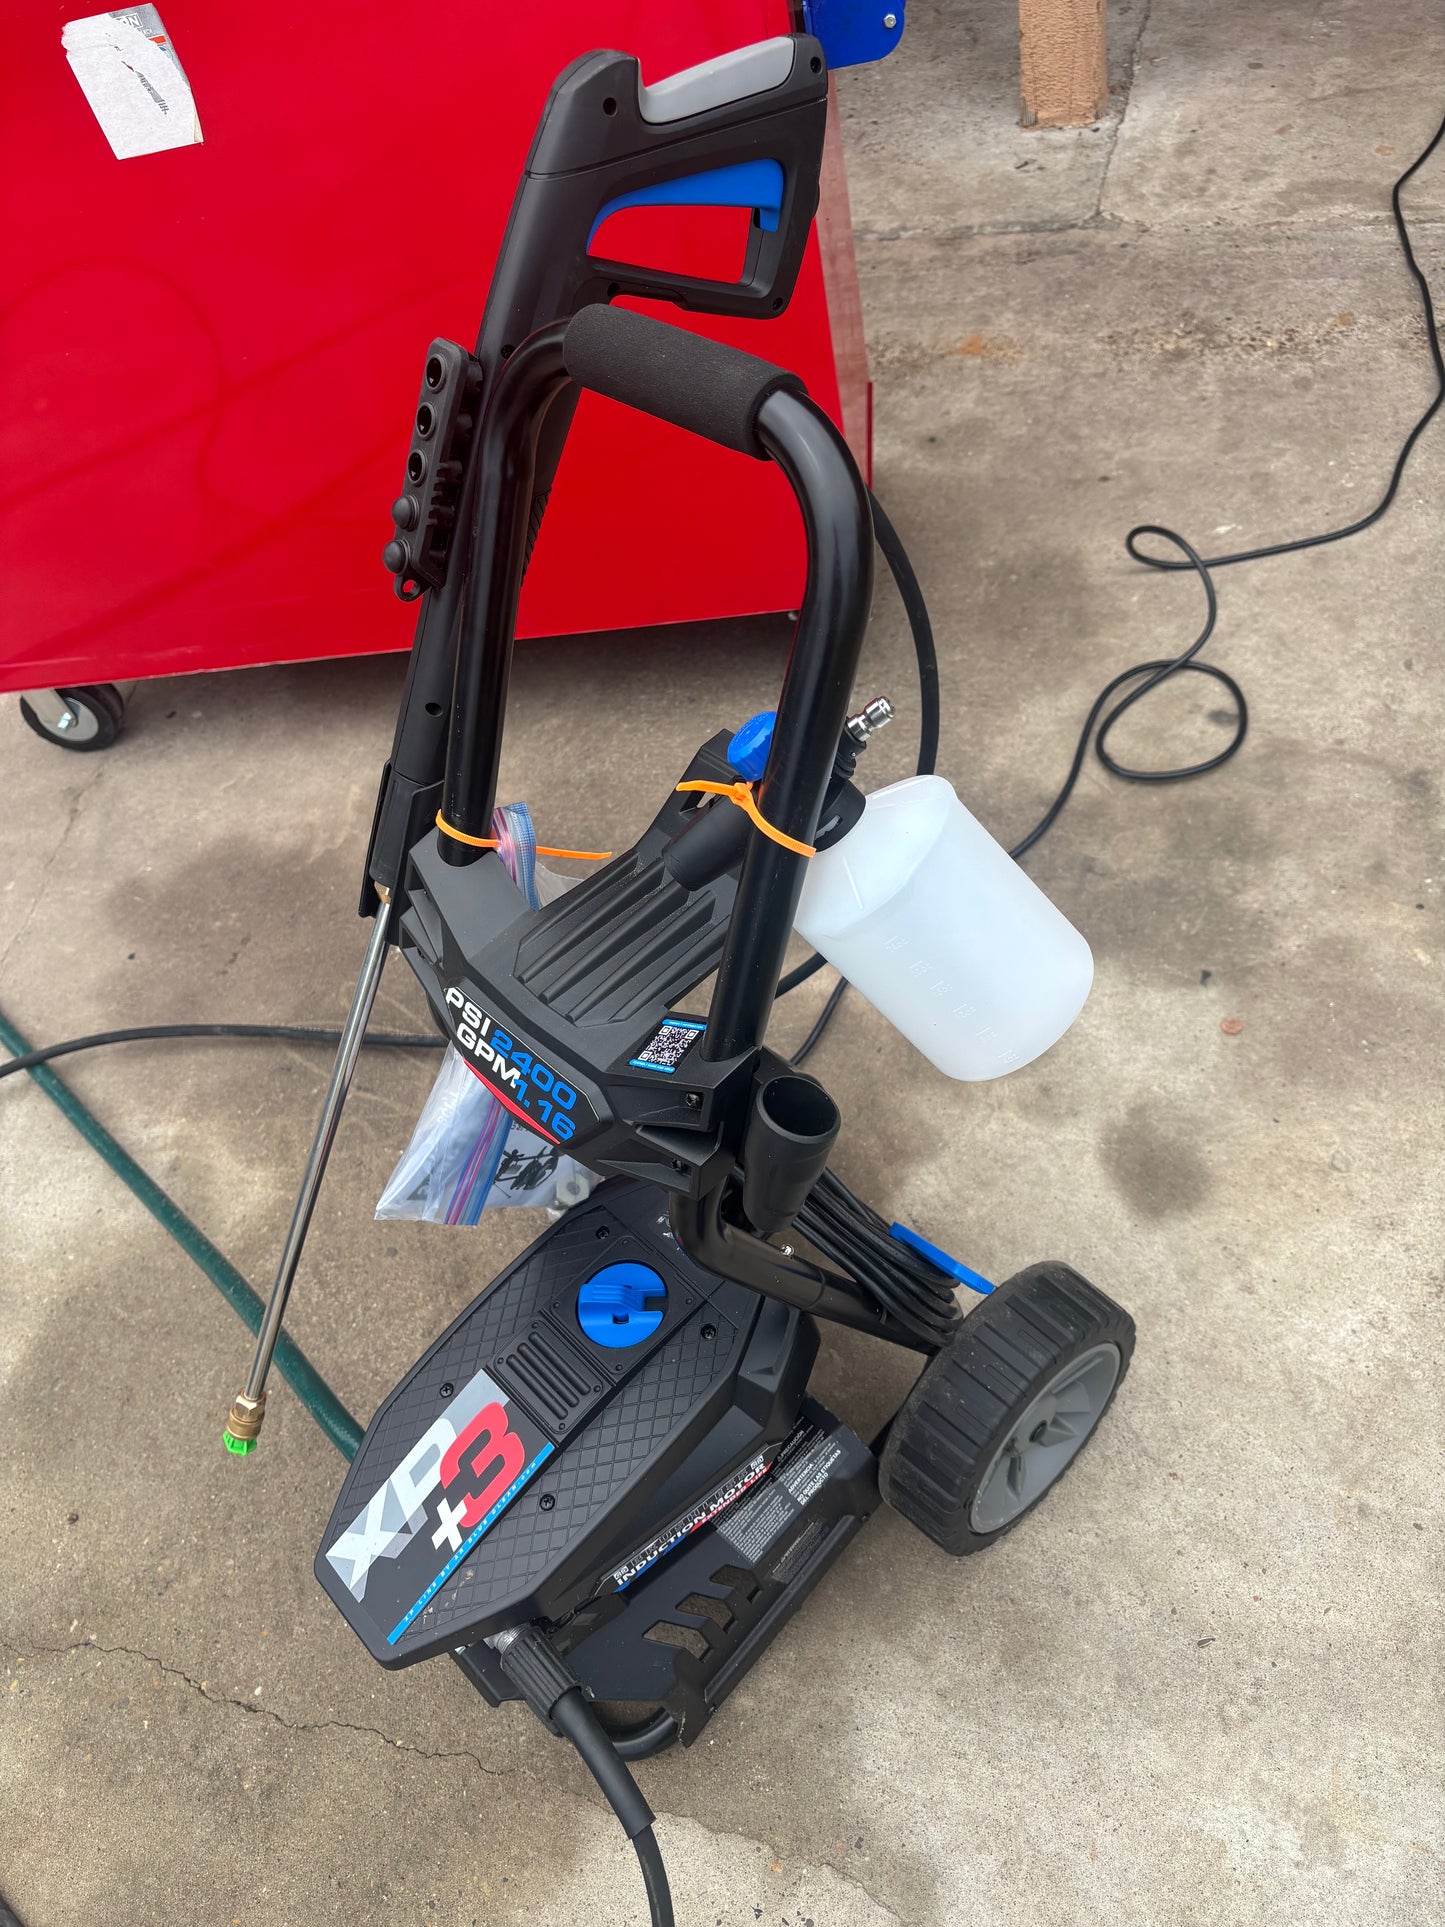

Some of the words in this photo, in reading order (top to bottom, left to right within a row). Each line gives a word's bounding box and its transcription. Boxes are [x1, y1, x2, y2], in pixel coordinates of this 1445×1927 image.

[445, 987, 491, 1037] PSI
[490, 1029, 577, 1111] 2400
[456, 1022, 521, 1089] GPM
[514, 1079, 576, 1141] 1.16
[701, 1486, 748, 1523] EXTENDED
[750, 1468, 769, 1485] LIFE
[802, 1481, 815, 1496] QUITE
[813, 1472, 822, 1483] LAS
[820, 1449, 841, 1474] ETIQUETAS
[807, 1472, 829, 1498] PRODUCTO
[403, 1609, 414, 1622] XP
[418, 1581, 437, 1605] LINE
[441, 1564, 450, 1577] BY
[454, 1547, 464, 1560] AR
[467, 1519, 488, 1543] BLUE
[616, 1512, 706, 1586] INDUCTION
[709, 1463, 766, 1511] MOTOR
